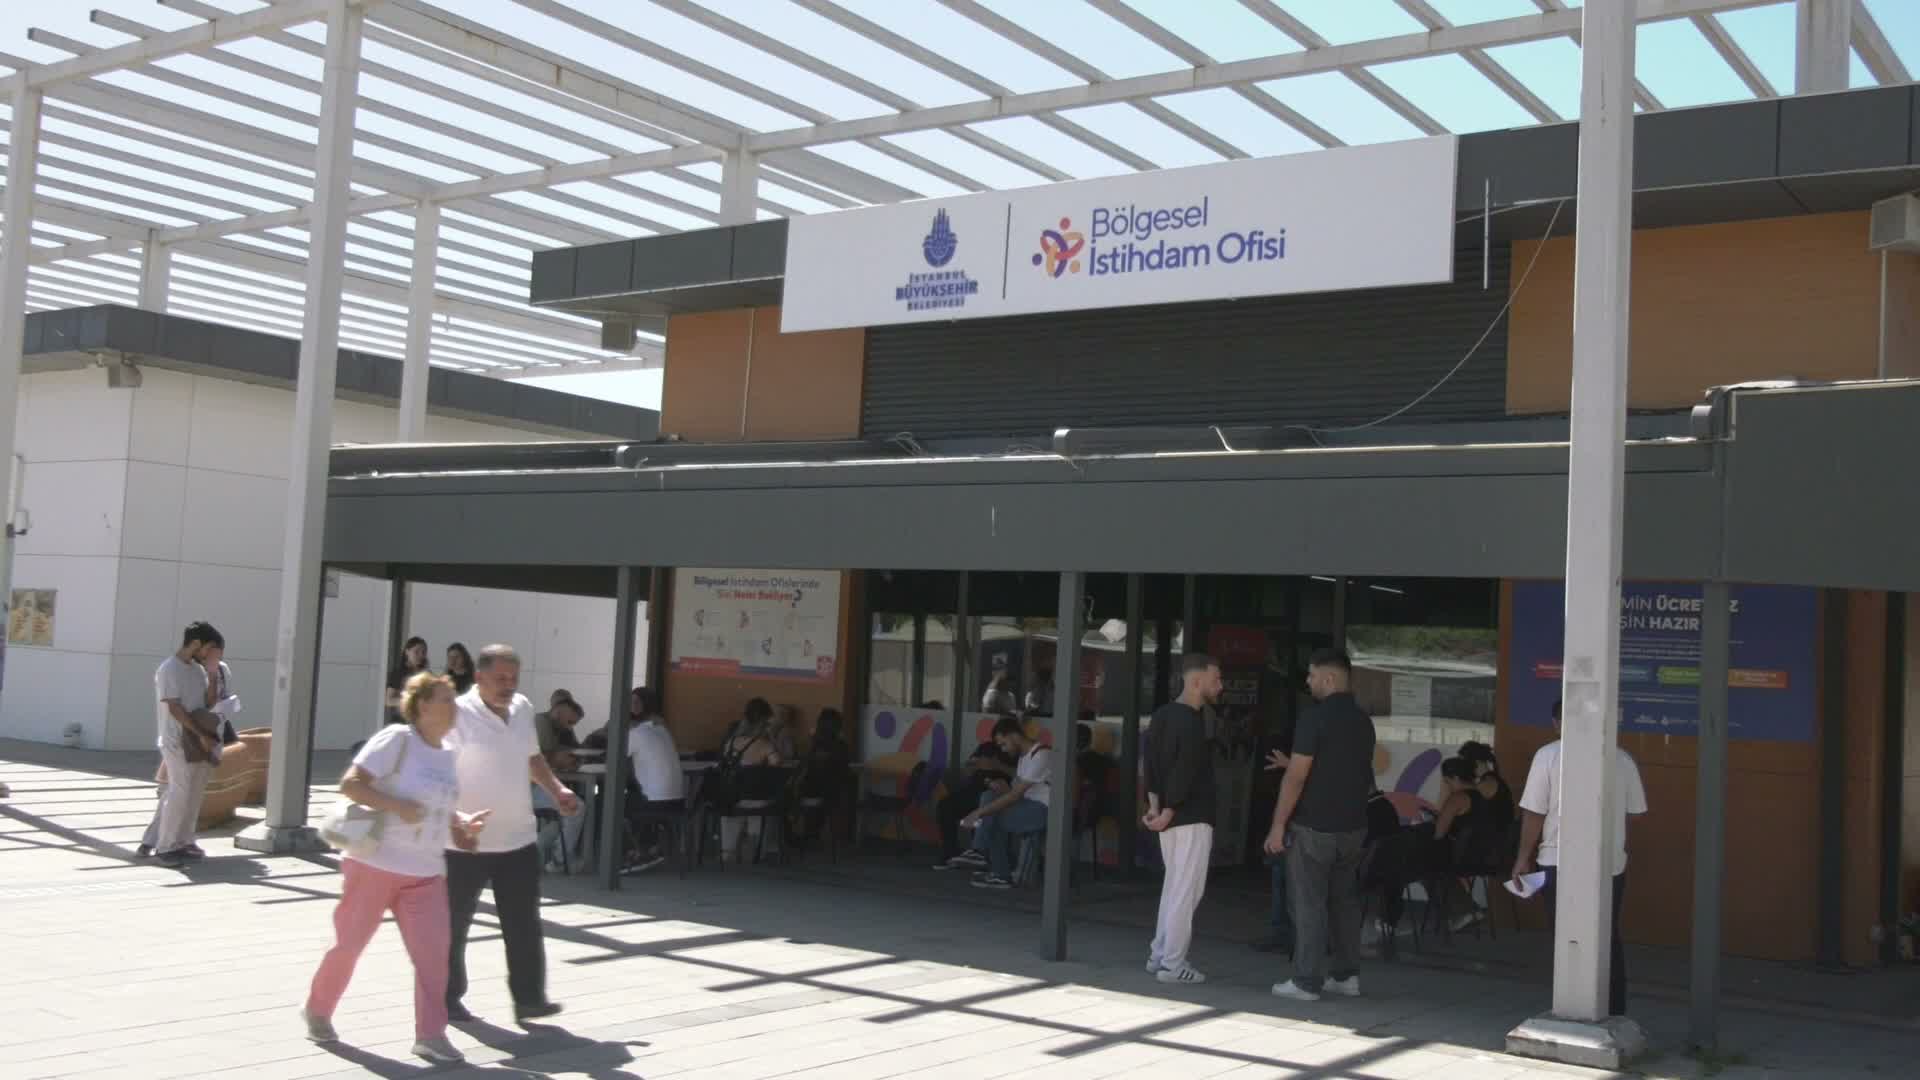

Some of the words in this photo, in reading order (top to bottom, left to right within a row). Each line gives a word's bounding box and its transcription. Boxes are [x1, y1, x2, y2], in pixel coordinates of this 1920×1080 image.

[1091, 197, 1208, 241] Bölgesel
[1089, 237, 1211, 276] İstihdam
[1217, 228, 1286, 264] Ofisi
[1649, 616, 1700, 631] HAZIR
